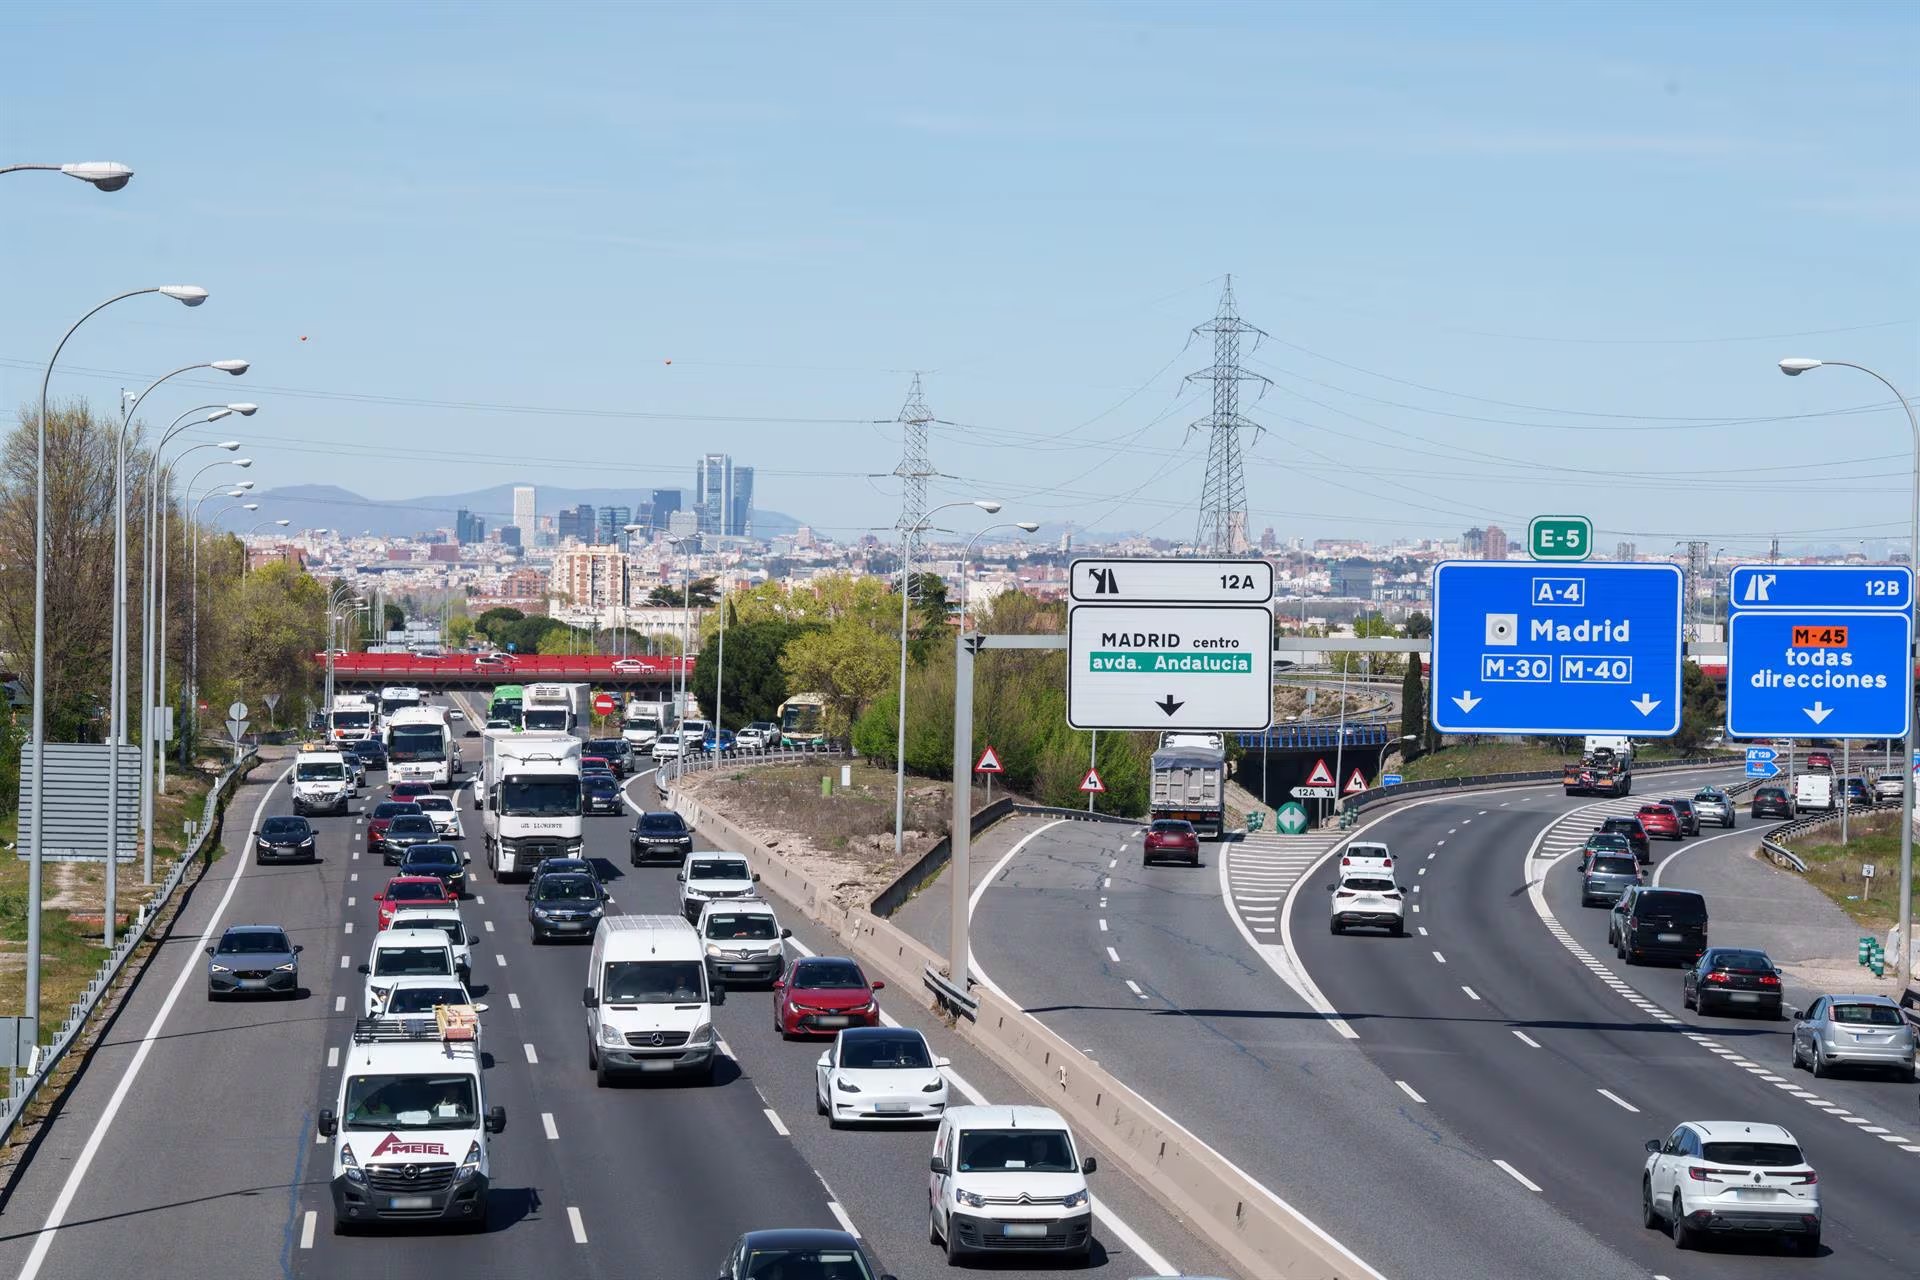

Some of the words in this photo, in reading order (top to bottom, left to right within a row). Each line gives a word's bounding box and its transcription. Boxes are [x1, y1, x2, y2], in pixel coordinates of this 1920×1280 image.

[1540, 529, 1580, 548] E-5
[1220, 574, 1255, 590] 12A
[1865, 580, 1900, 597] 12B
[1537, 582, 1580, 602] A-4
[1101, 632, 1181, 649] MADRID
[1192, 636, 1240, 649] centro
[1530, 619, 1631, 643] Madrid
[1794, 629, 1846, 645] M-45
[1092, 656, 1143, 671] avda.
[1153, 654, 1249, 672] Andalucía
[1785, 647, 1853, 666] todas
[1486, 659, 1547, 679] M-30
[1564, 660, 1628, 680] M-40
[1750, 669, 1887, 689] direcciones
[1298, 788, 1316, 797] 12A
[371, 1132, 449, 1157] AMETEL
